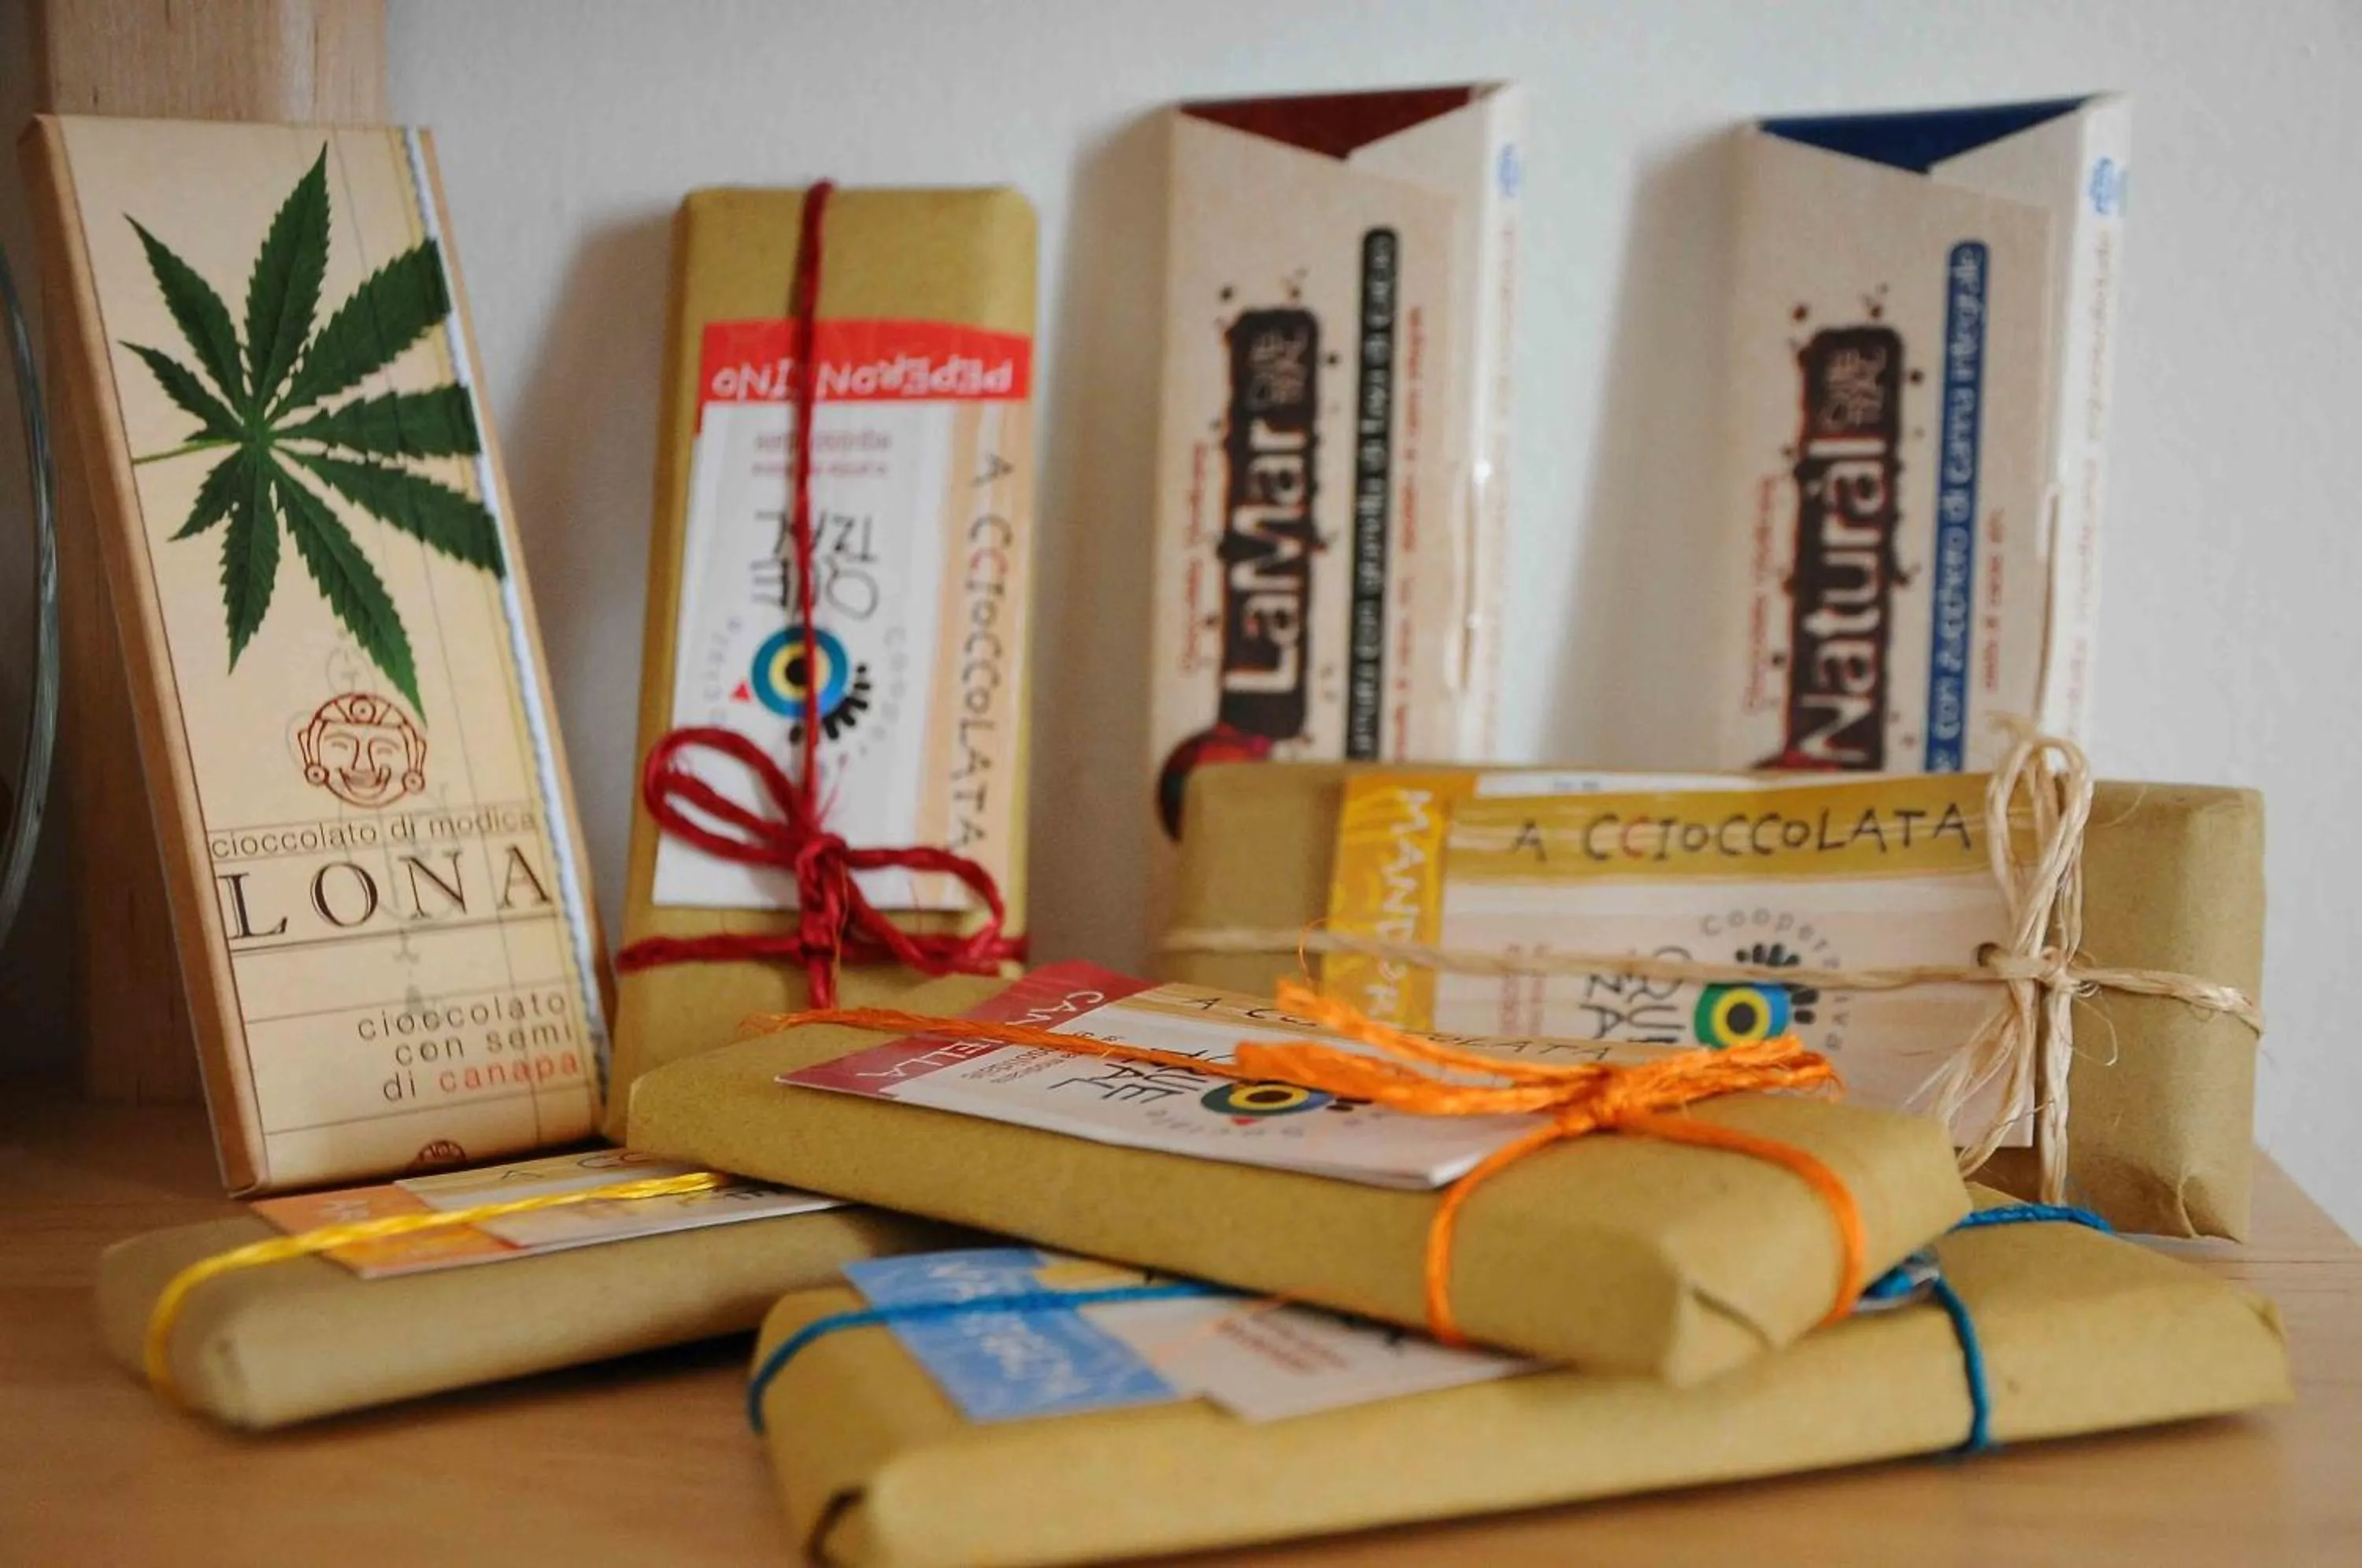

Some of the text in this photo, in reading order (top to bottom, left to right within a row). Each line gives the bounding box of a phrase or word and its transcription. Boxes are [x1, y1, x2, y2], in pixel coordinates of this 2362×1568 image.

[712, 355, 1013, 401] PEPERONINO
[1223, 418, 1306, 693] LaMar
[211, 808, 536, 860] cioccolato di modica
[217, 844, 553, 941] LONA
[357, 991, 567, 1041] cioccolato
[395, 1020, 573, 1067] con semi
[383, 1050, 579, 1102] di canapa
